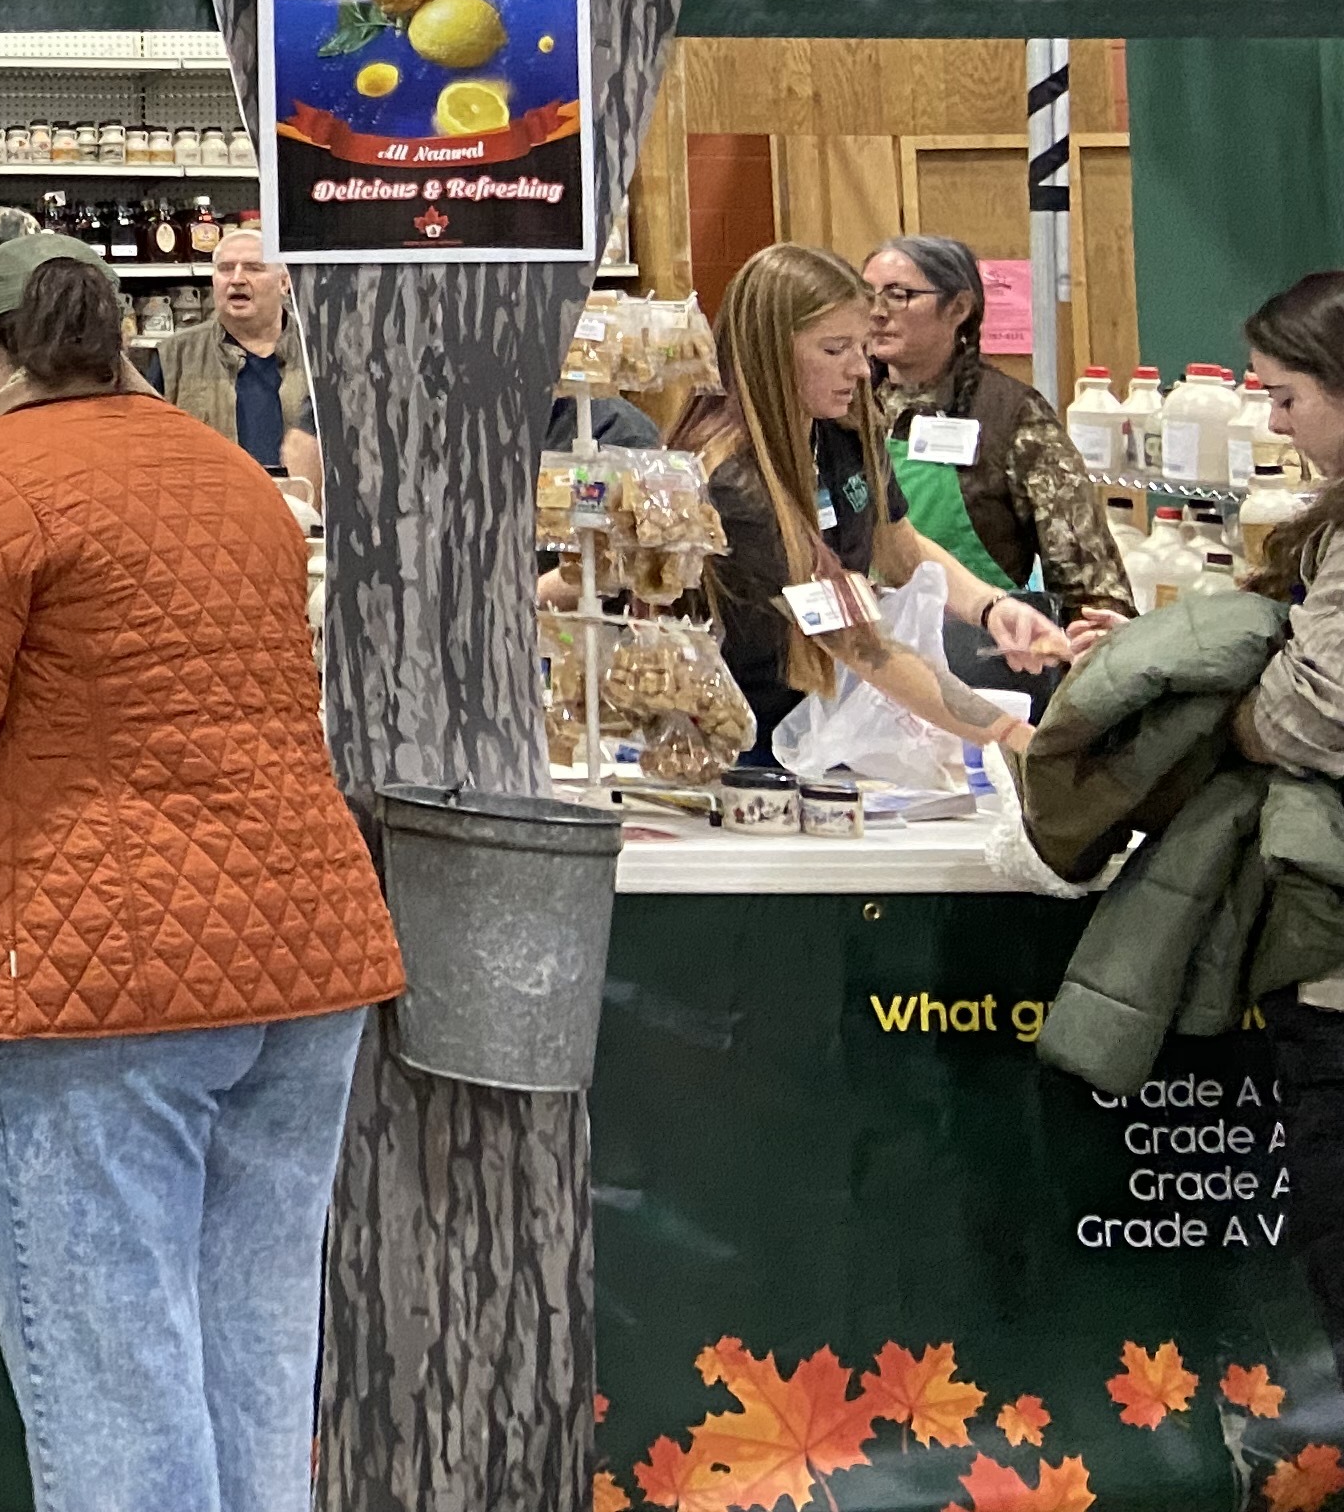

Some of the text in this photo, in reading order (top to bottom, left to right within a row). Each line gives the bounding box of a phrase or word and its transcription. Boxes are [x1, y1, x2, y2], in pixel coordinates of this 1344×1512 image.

[413, 141, 484, 161] Natural
[314, 178, 564, 203] Delicious & Refreshing
[870, 992, 997, 1033] What
[1236, 1076, 1262, 1108] A
[1124, 1118, 1254, 1155] Grade
[1129, 1167, 1259, 1202] Grade
[1077, 1213, 1208, 1248] Grade
[1222, 1215, 1248, 1248] A
